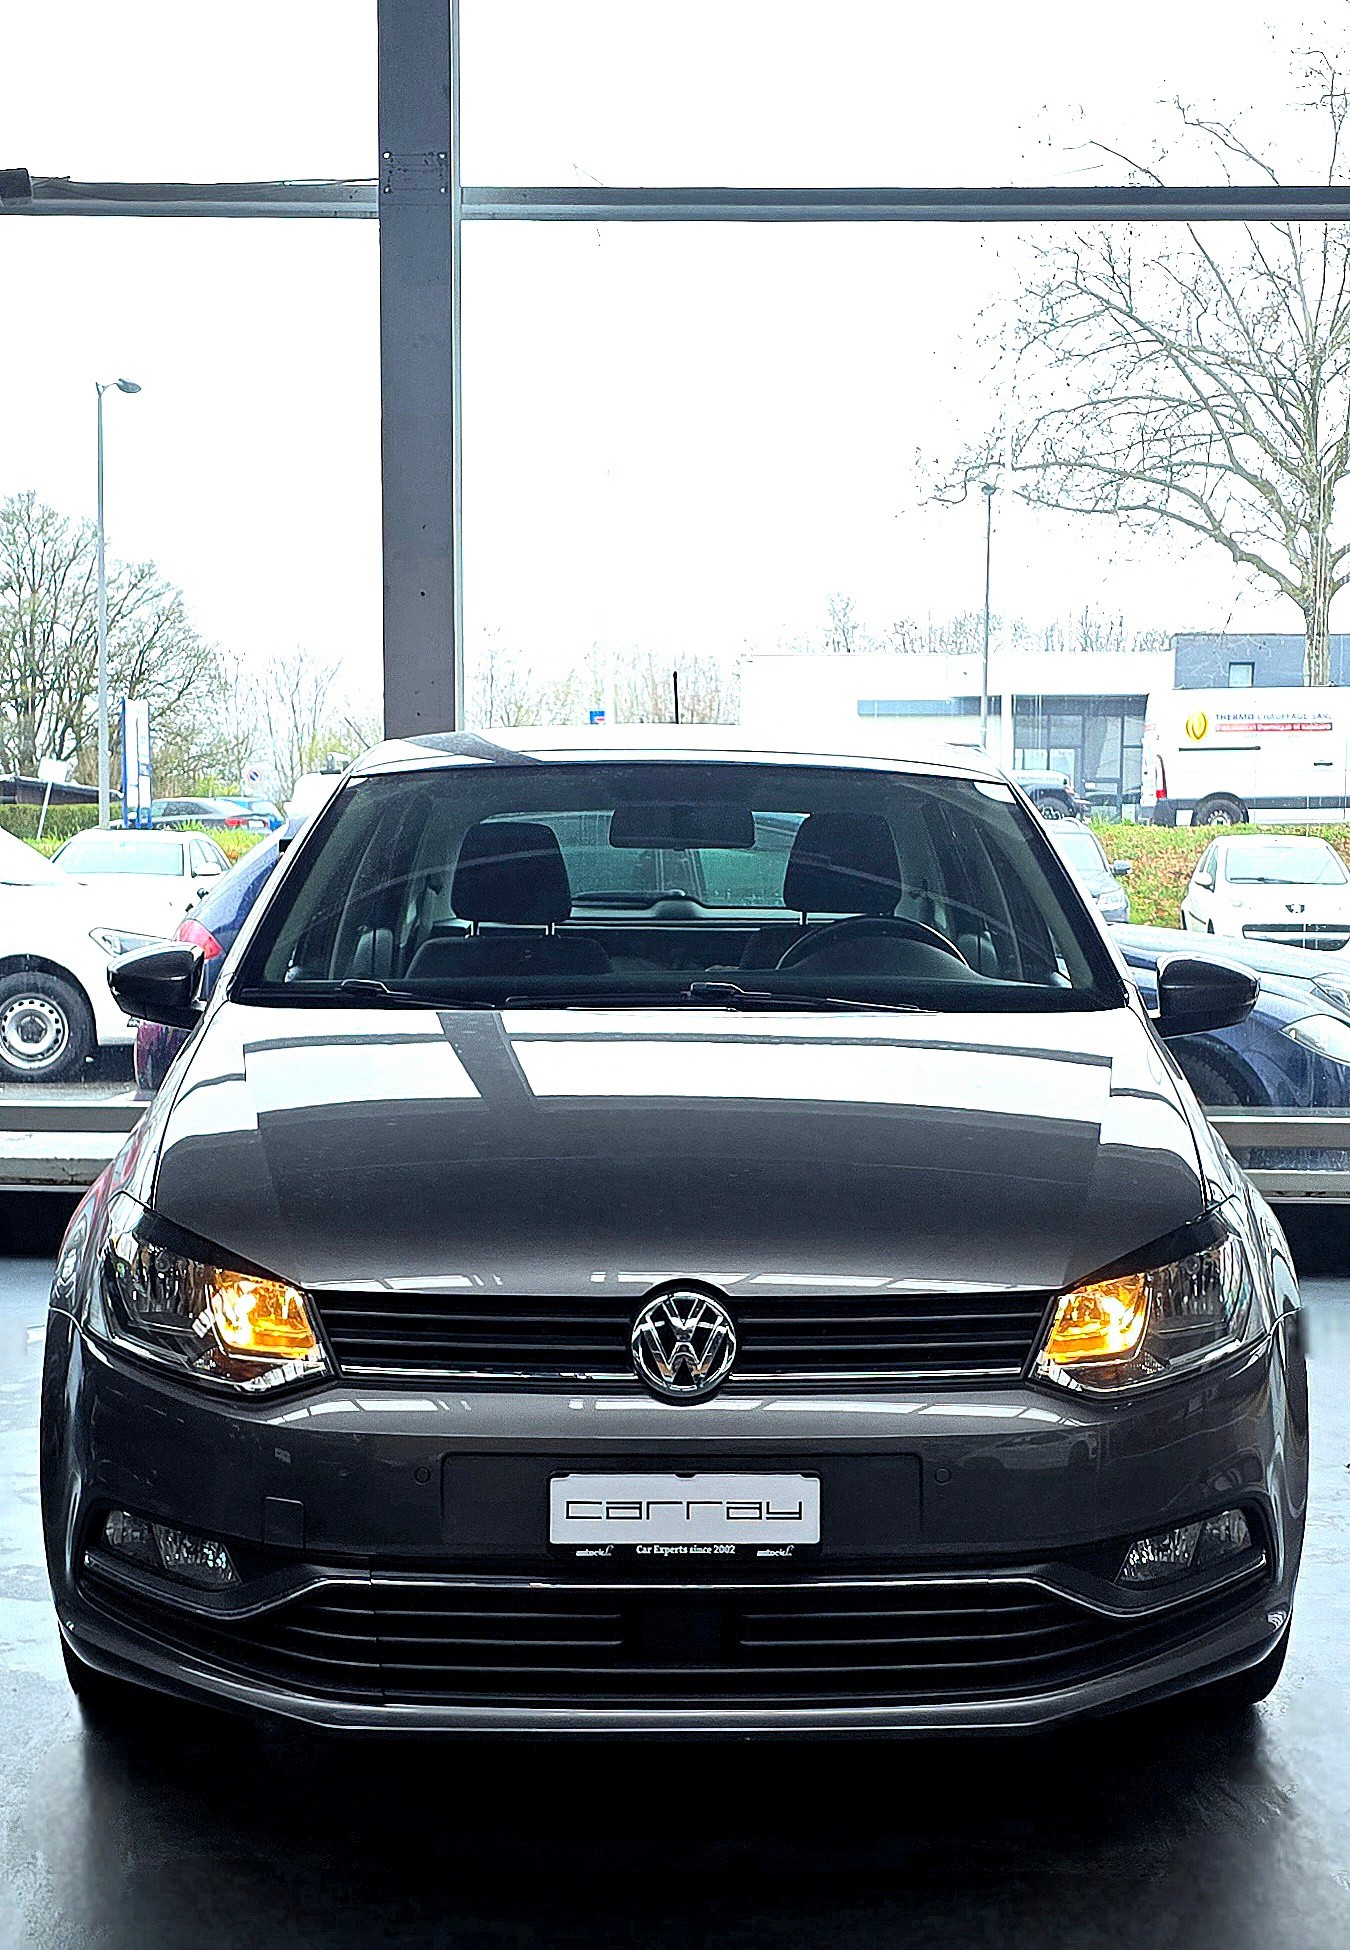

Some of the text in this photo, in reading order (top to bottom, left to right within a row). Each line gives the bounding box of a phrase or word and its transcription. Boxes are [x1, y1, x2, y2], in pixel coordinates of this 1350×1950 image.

[565, 1500, 803, 1521] carray
[636, 1544, 736, 1557] Car Experts since 2002
